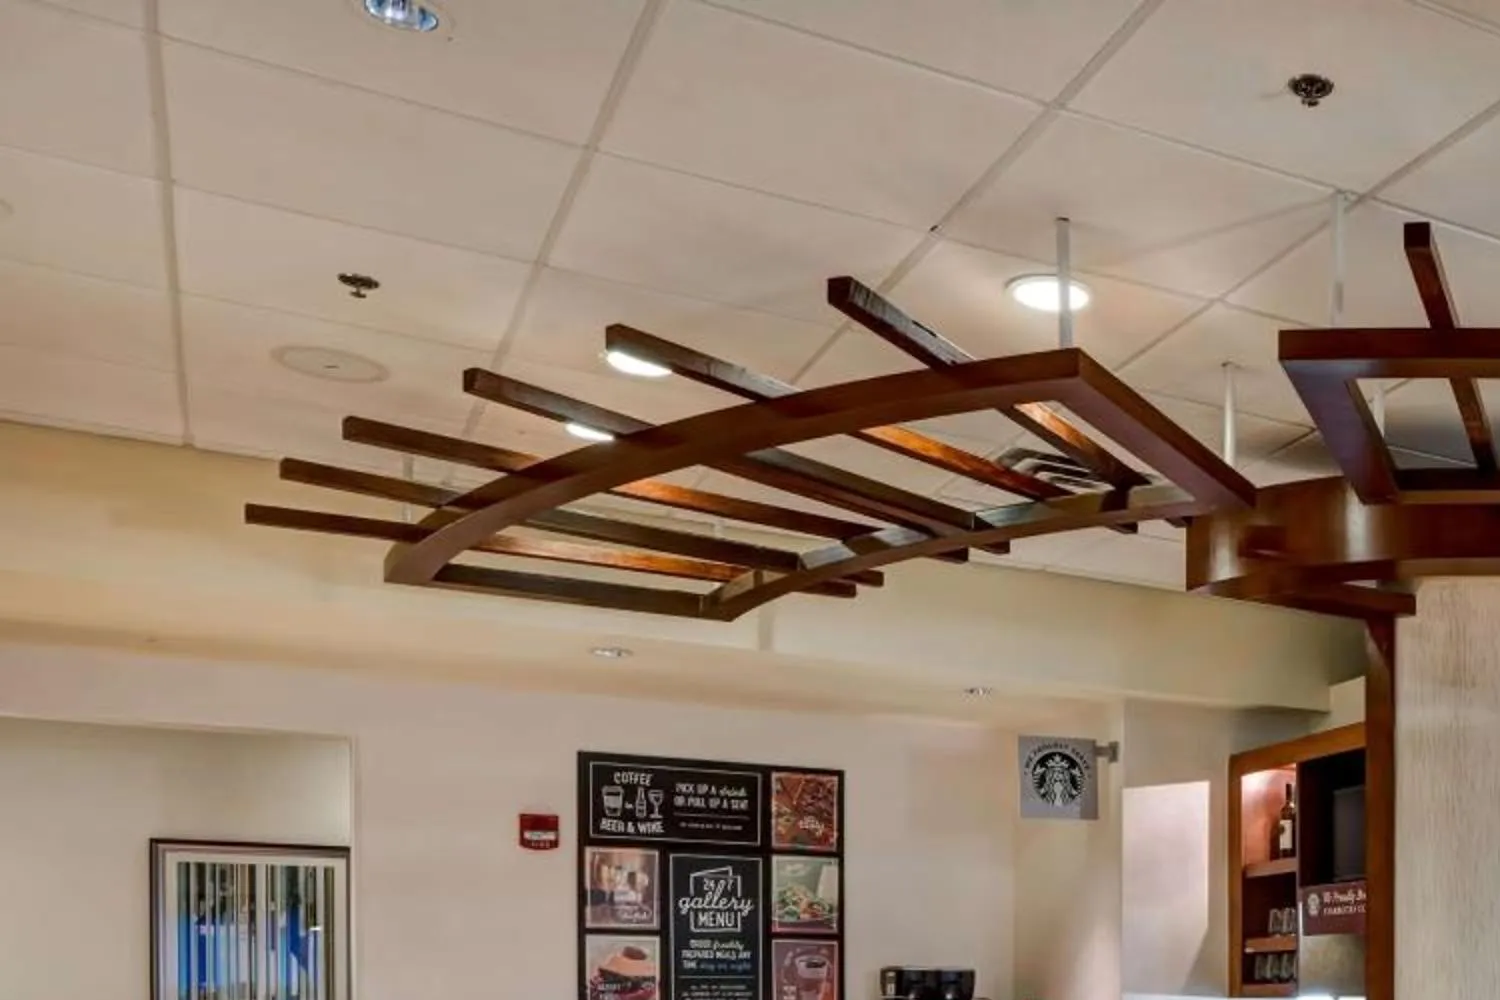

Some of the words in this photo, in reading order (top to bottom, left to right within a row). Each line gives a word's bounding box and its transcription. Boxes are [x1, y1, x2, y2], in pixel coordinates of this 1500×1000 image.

[613, 771, 654, 786] COFFEE
[675, 783, 695, 794] PICK
[697, 784, 709, 795] UP
[710, 785, 717, 795] A
[709, 797, 721, 809] UP
[722, 798, 729, 809] A
[600, 818, 625, 832] BEER
[637, 820, 665, 834] WINE
[678, 879, 755, 917] gallery
[698, 911, 735, 927] MENU
